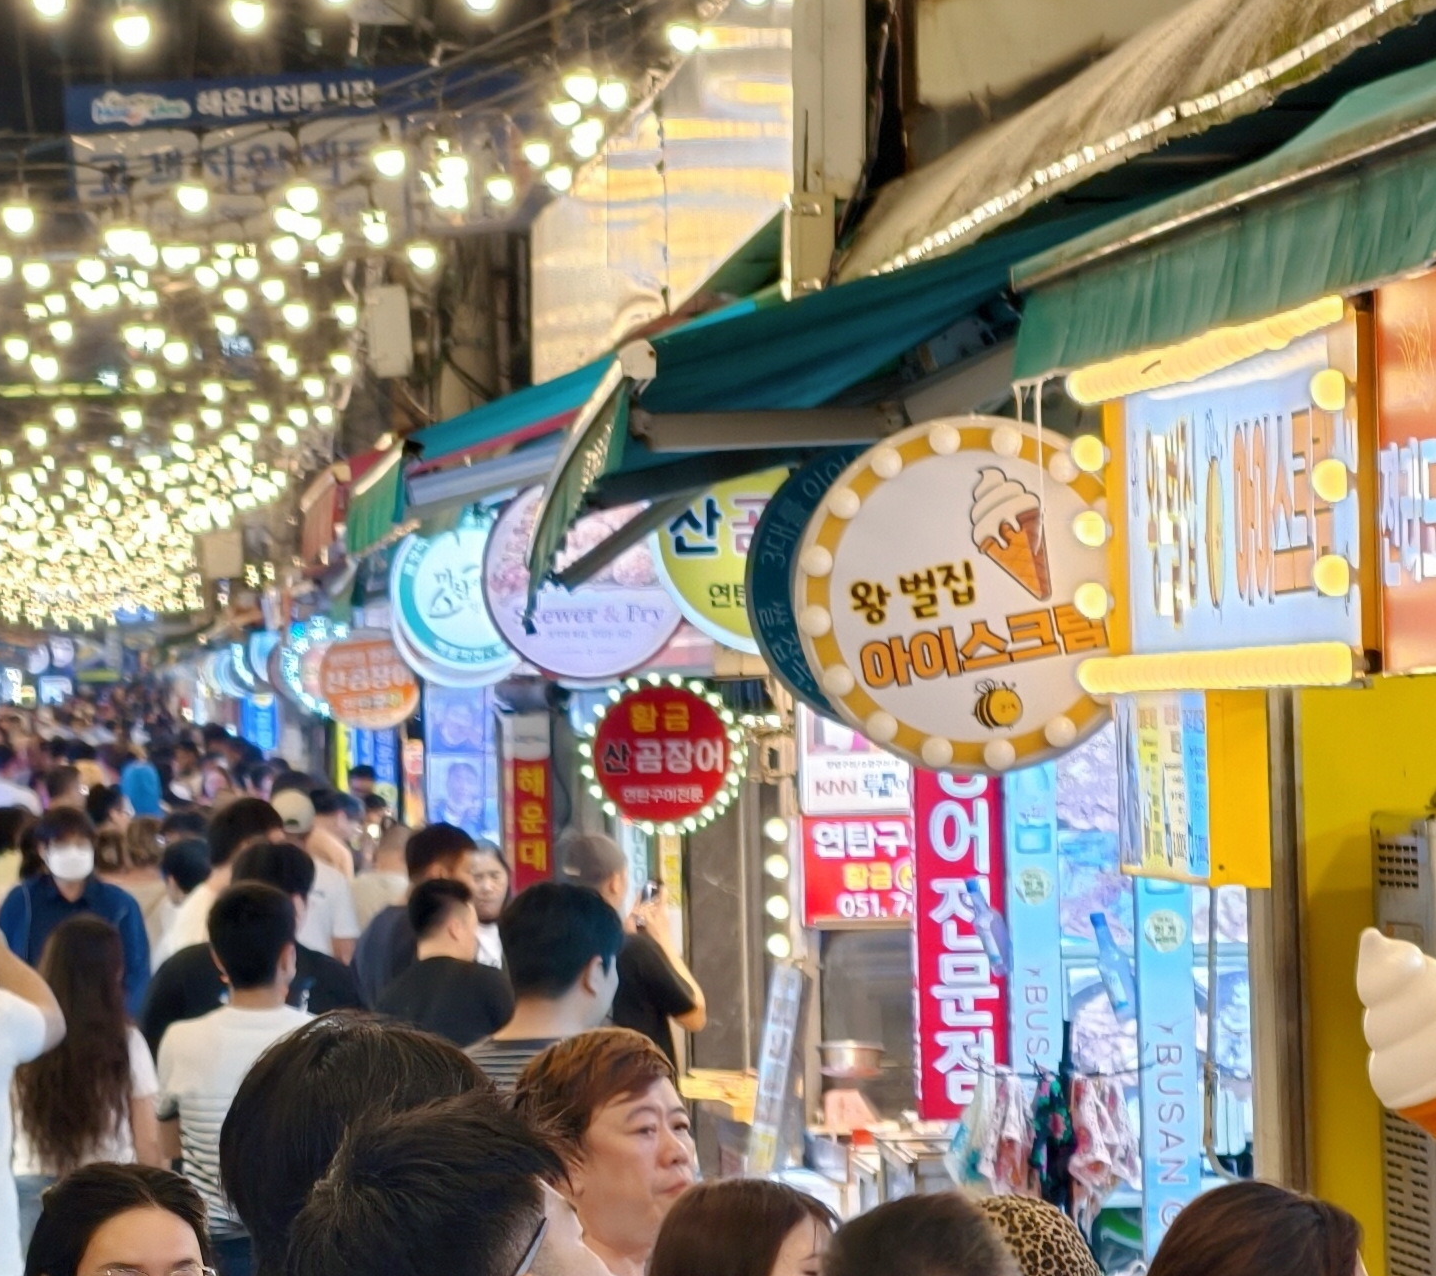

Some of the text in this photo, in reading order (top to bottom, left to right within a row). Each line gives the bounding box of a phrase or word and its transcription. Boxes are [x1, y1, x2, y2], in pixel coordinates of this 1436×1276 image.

[850, 560, 976, 625] 왕 벌집
[860, 603, 1109, 689] 아이스크림
[603, 738, 724, 775] 산곰장어
[622, 784, 704, 804] 연탄구이전문
[517, 766, 547, 872] 해운대
[1156, 1044, 1188, 1185] BUSAN
